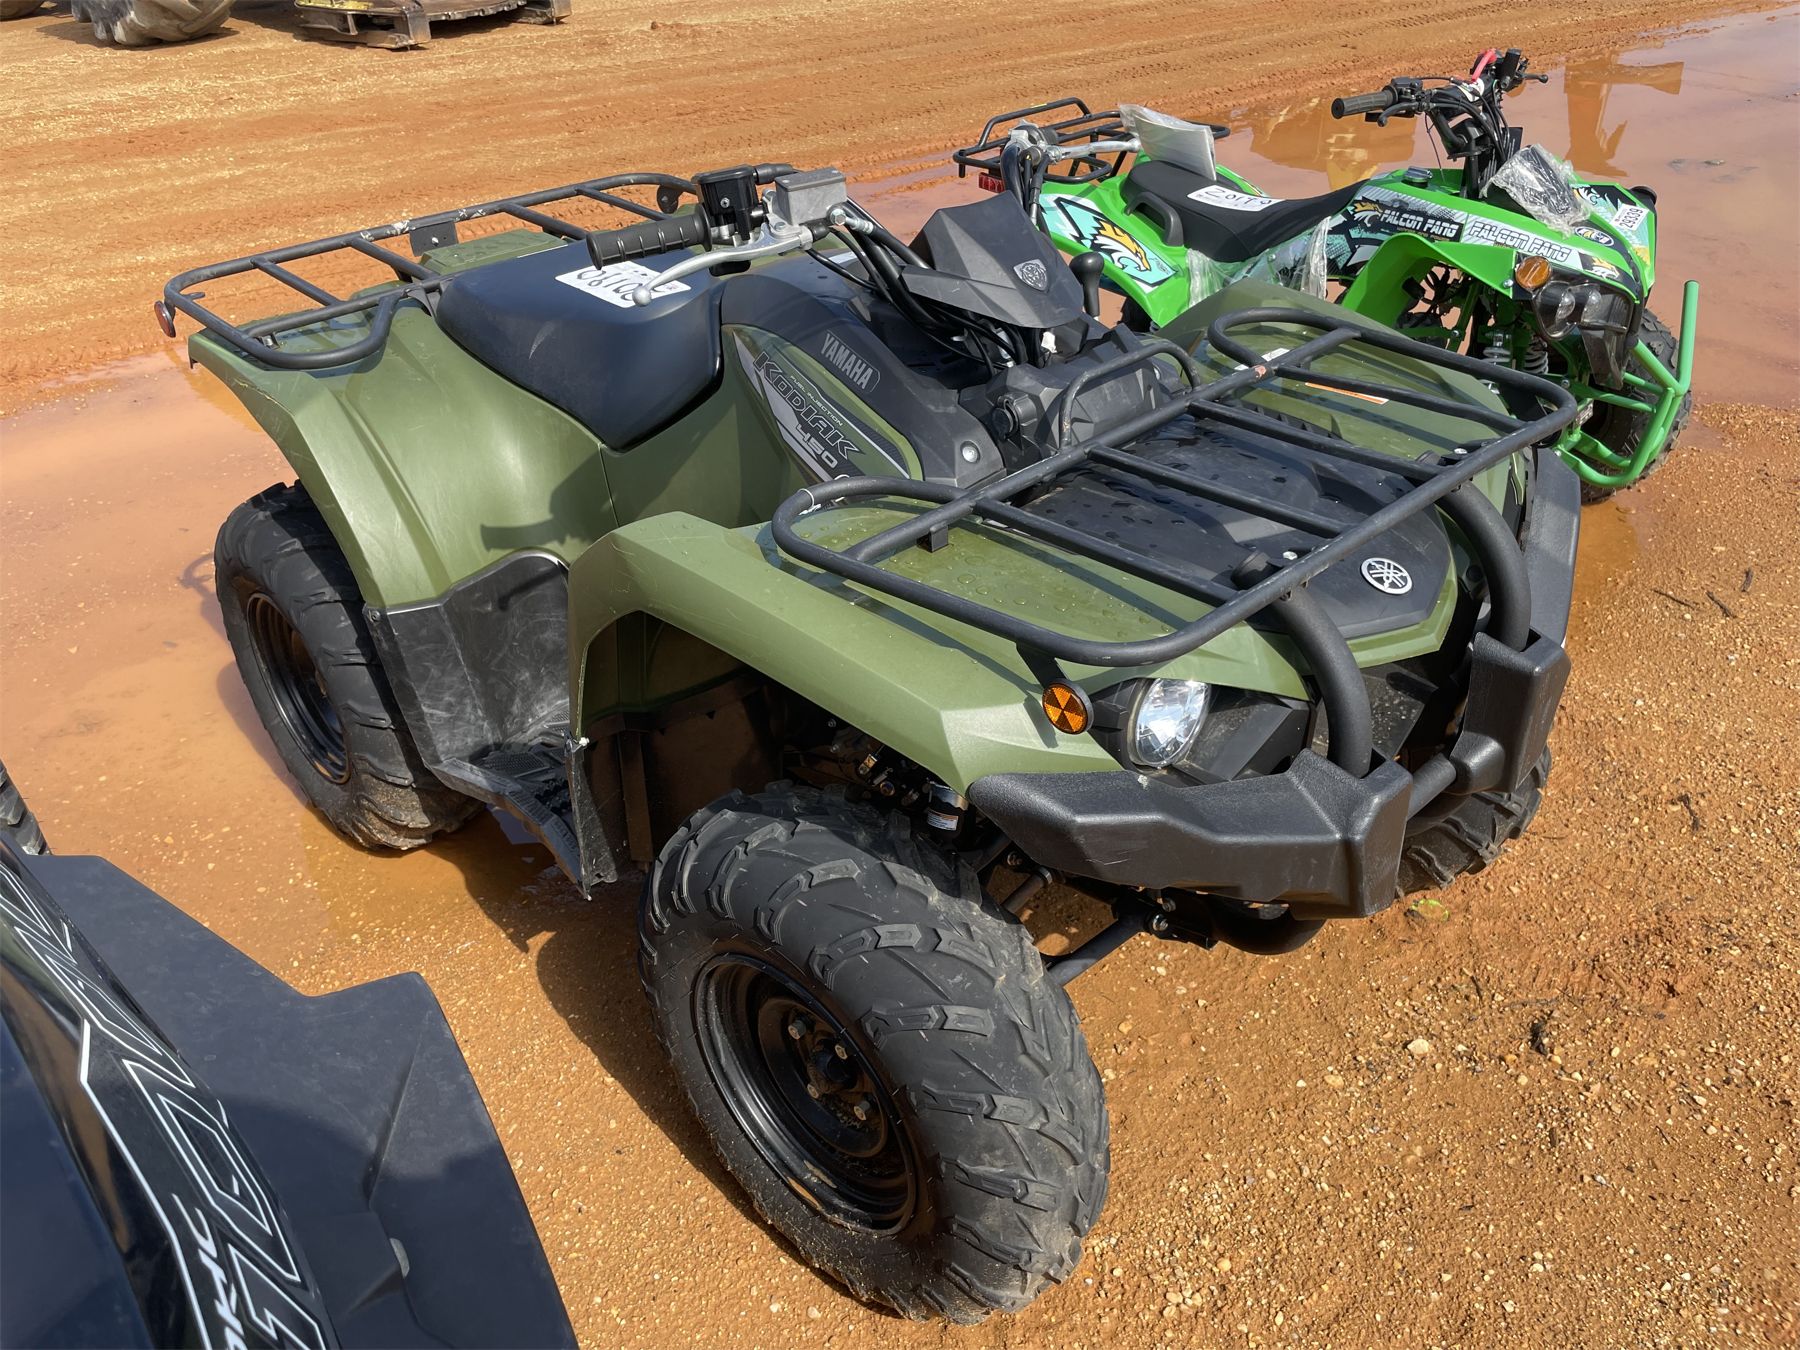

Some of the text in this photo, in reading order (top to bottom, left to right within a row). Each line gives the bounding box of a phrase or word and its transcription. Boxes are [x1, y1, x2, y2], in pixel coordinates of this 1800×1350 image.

[1380, 209, 1424, 230] FALCON
[1423, 218, 1460, 238] FANG
[1468, 220, 1530, 250] FALCON
[1529, 237, 1572, 262] FANG
[821, 333, 874, 390] YAMAHA
[753, 351, 860, 460] KODIAK
[789, 375, 844, 427] FUEL INJECTION
[795, 423, 839, 469] 450
